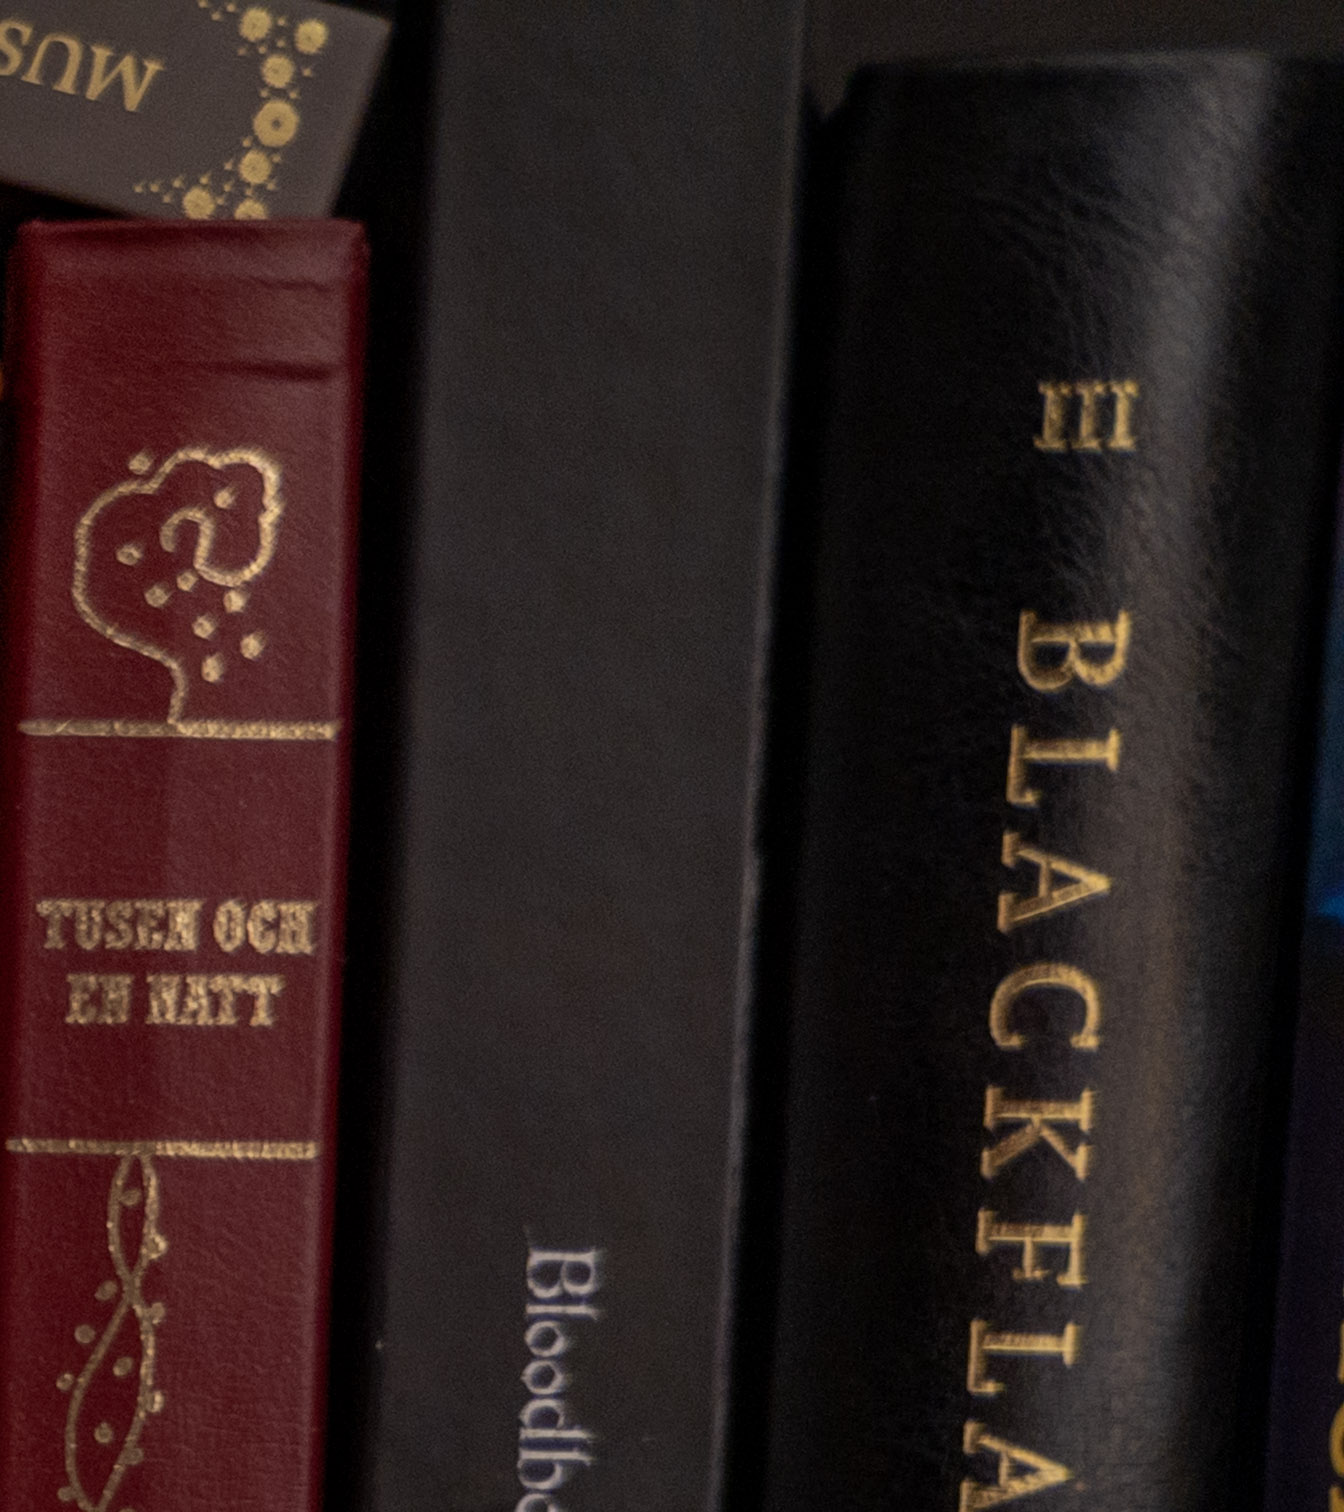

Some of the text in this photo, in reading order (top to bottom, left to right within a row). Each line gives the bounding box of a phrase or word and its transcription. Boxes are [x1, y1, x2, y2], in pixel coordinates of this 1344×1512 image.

[1033, 379, 1139, 453] III
[35, 899, 319, 955] TUSEN OCH
[64, 972, 287, 1027] EN NATT
